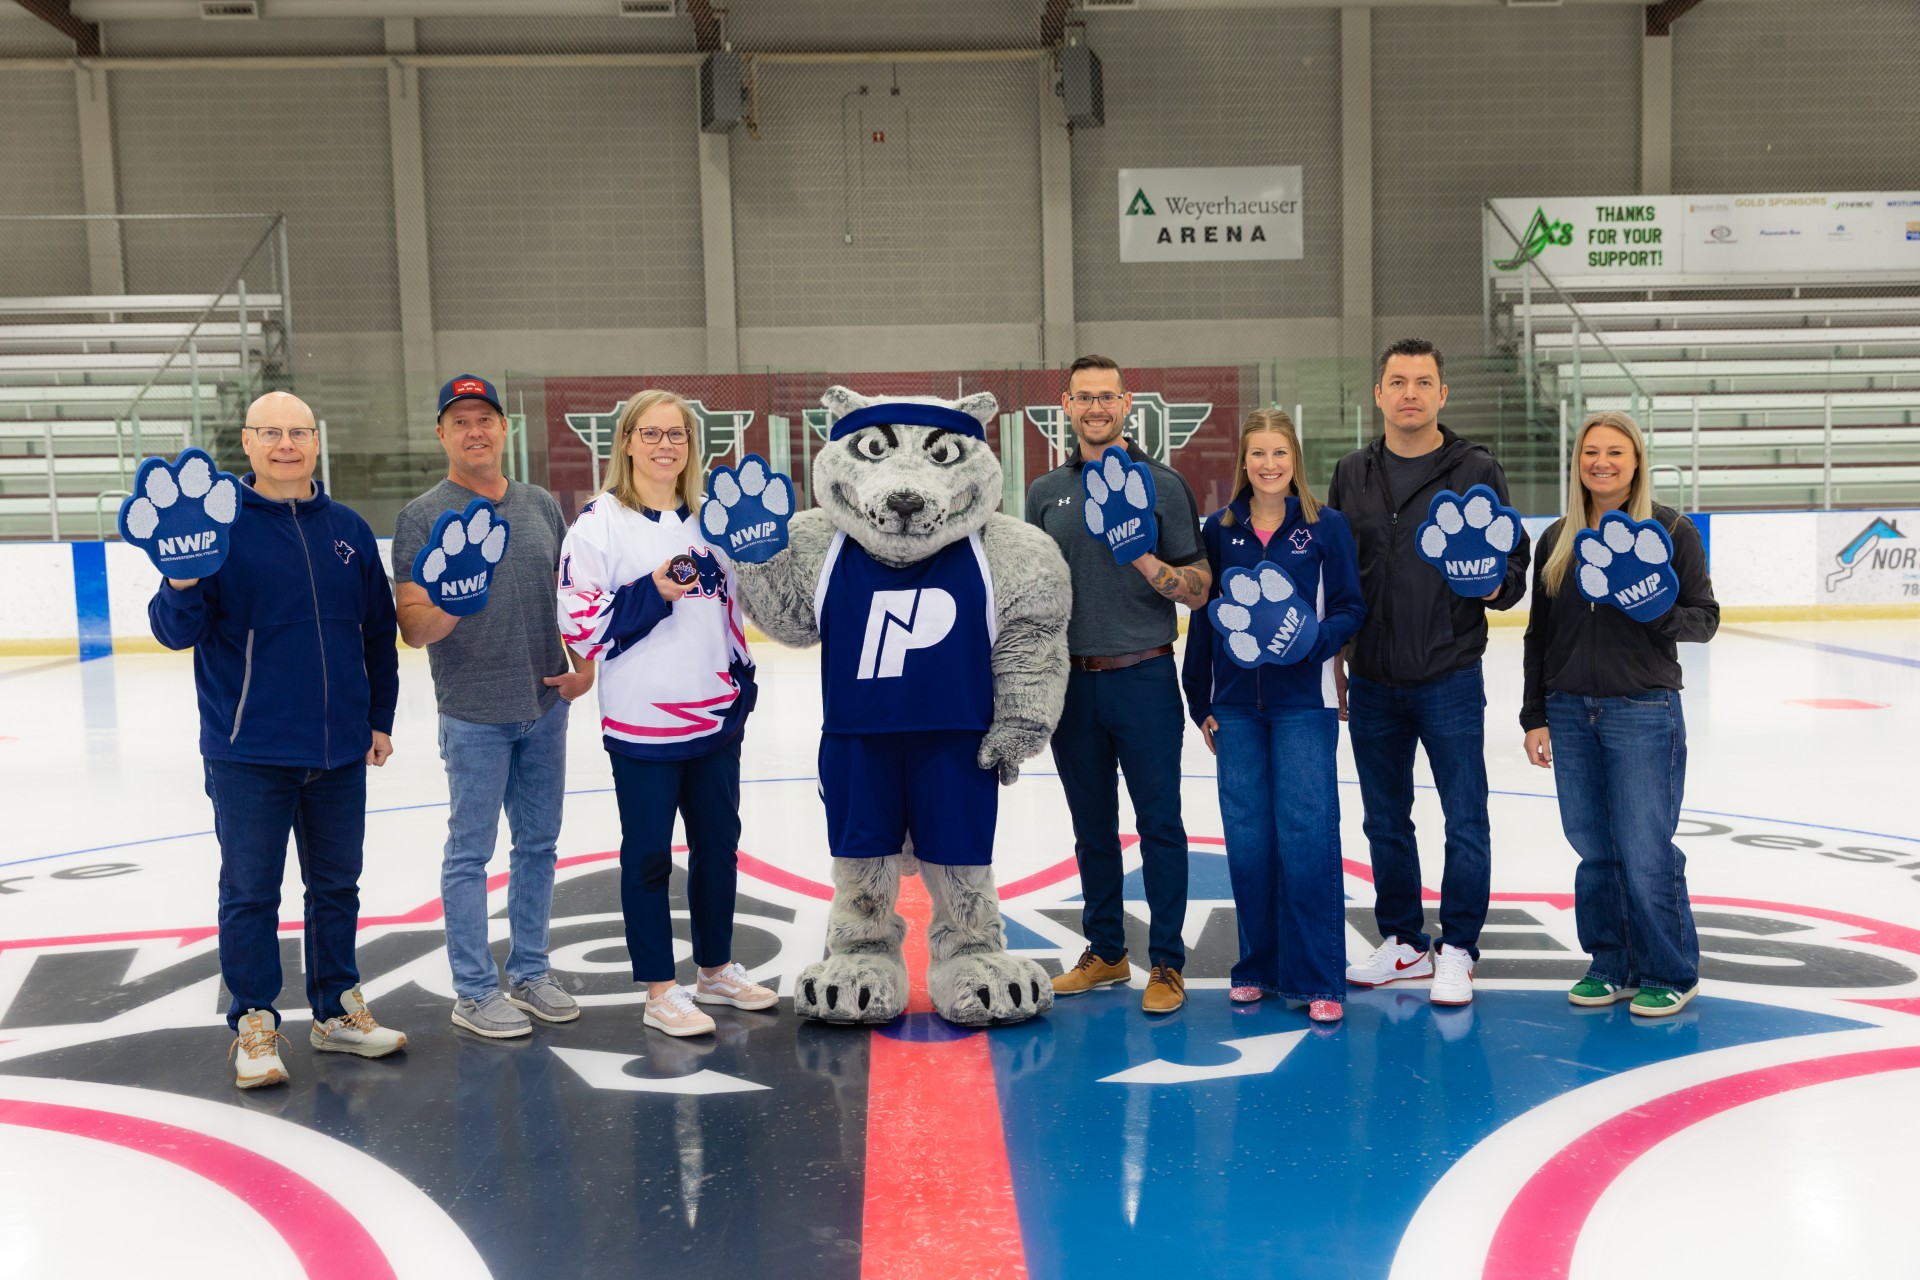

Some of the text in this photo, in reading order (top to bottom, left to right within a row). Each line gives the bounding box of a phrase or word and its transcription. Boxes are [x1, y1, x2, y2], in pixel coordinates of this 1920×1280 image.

[1165, 196, 1298, 220] Weyerhaeuser
[1596, 206, 1655, 223] THANKS
[1735, 198, 1765, 207] GOLD
[1767, 197, 1828, 207] SPONSORS
[1156, 225, 1267, 244] ARENA
[1588, 228, 1662, 245] FOR YOUR
[1588, 250, 1663, 267] SUPPORT!
[158, 530, 217, 556] NWP
[730, 521, 777, 548] NWP
[1106, 517, 1141, 546] NWP
[560, 552, 574, 590] 1
[1445, 557, 1496, 576] NWP
[1872, 547, 1920, 570] NOR
[441, 570, 487, 596] NWP
[1614, 572, 1661, 606] NWP
[1266, 606, 1300, 656] NWP
[0, 905, 1918, 1030] WOVES
